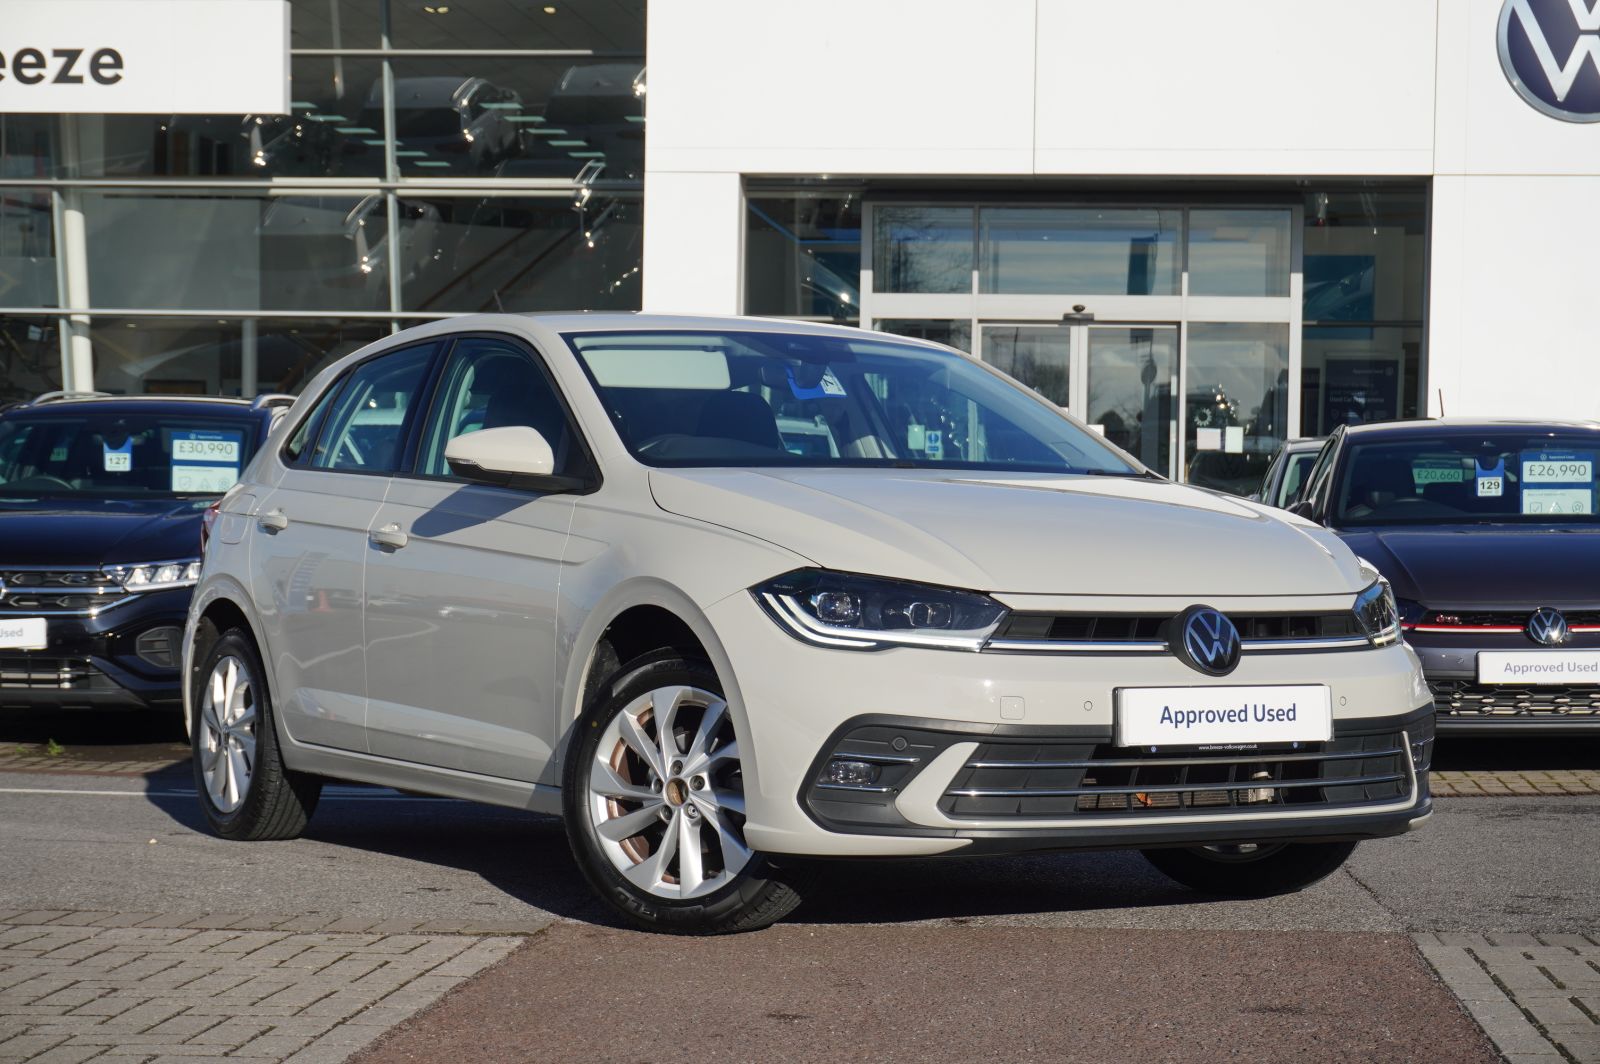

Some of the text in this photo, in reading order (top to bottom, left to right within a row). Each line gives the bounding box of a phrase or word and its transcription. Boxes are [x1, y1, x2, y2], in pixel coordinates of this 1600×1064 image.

[0, 47, 124, 85] eze
[179, 442, 233, 455] £30,990
[109, 456, 128, 465] 127
[1417, 470, 1460, 480] £20,660
[1529, 464, 1587, 478] £26,990
[1481, 481, 1500, 490] 129
[1504, 662, 1598, 675] Approved Used
[1160, 703, 1297, 728] Approved Used
